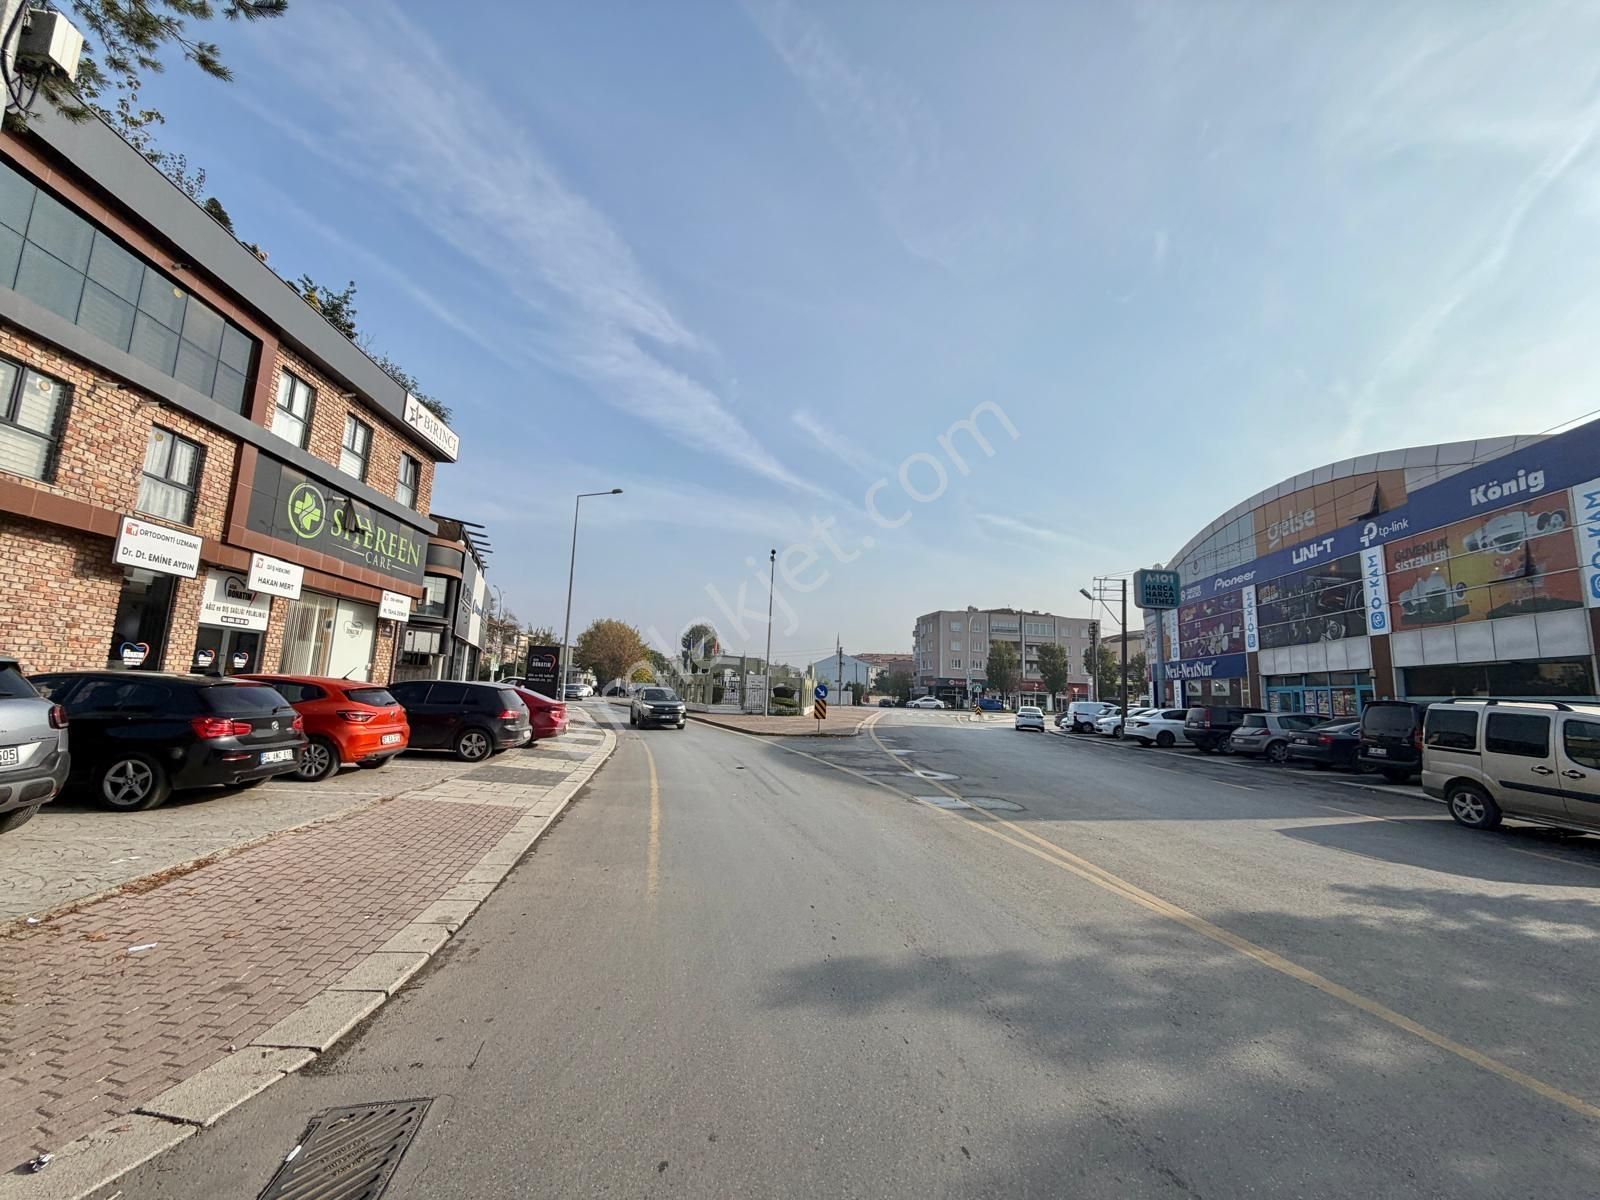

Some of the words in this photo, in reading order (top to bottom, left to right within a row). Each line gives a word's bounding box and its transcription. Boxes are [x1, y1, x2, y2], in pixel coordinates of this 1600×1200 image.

[1470, 469, 1545, 507] König
[139, 528, 176, 543] ORTODONTİ
[176, 538, 199, 550] UZMANI
[1378, 518, 1409, 538] tp-link
[121, 546, 133, 557] Dr.
[135, 549, 147, 560] Dt.
[148, 552, 173, 566] EMİNE
[172, 560, 195, 572] AYDIN
[365, 551, 392, 571] CARE
[1292, 537, 1335, 565] UNI-T
[257, 576, 278, 588] HAKAN
[278, 581, 295, 591] MERT
[1214, 570, 1256, 591] Pioneer
[1367, 554, 1382, 610] O-KAM
